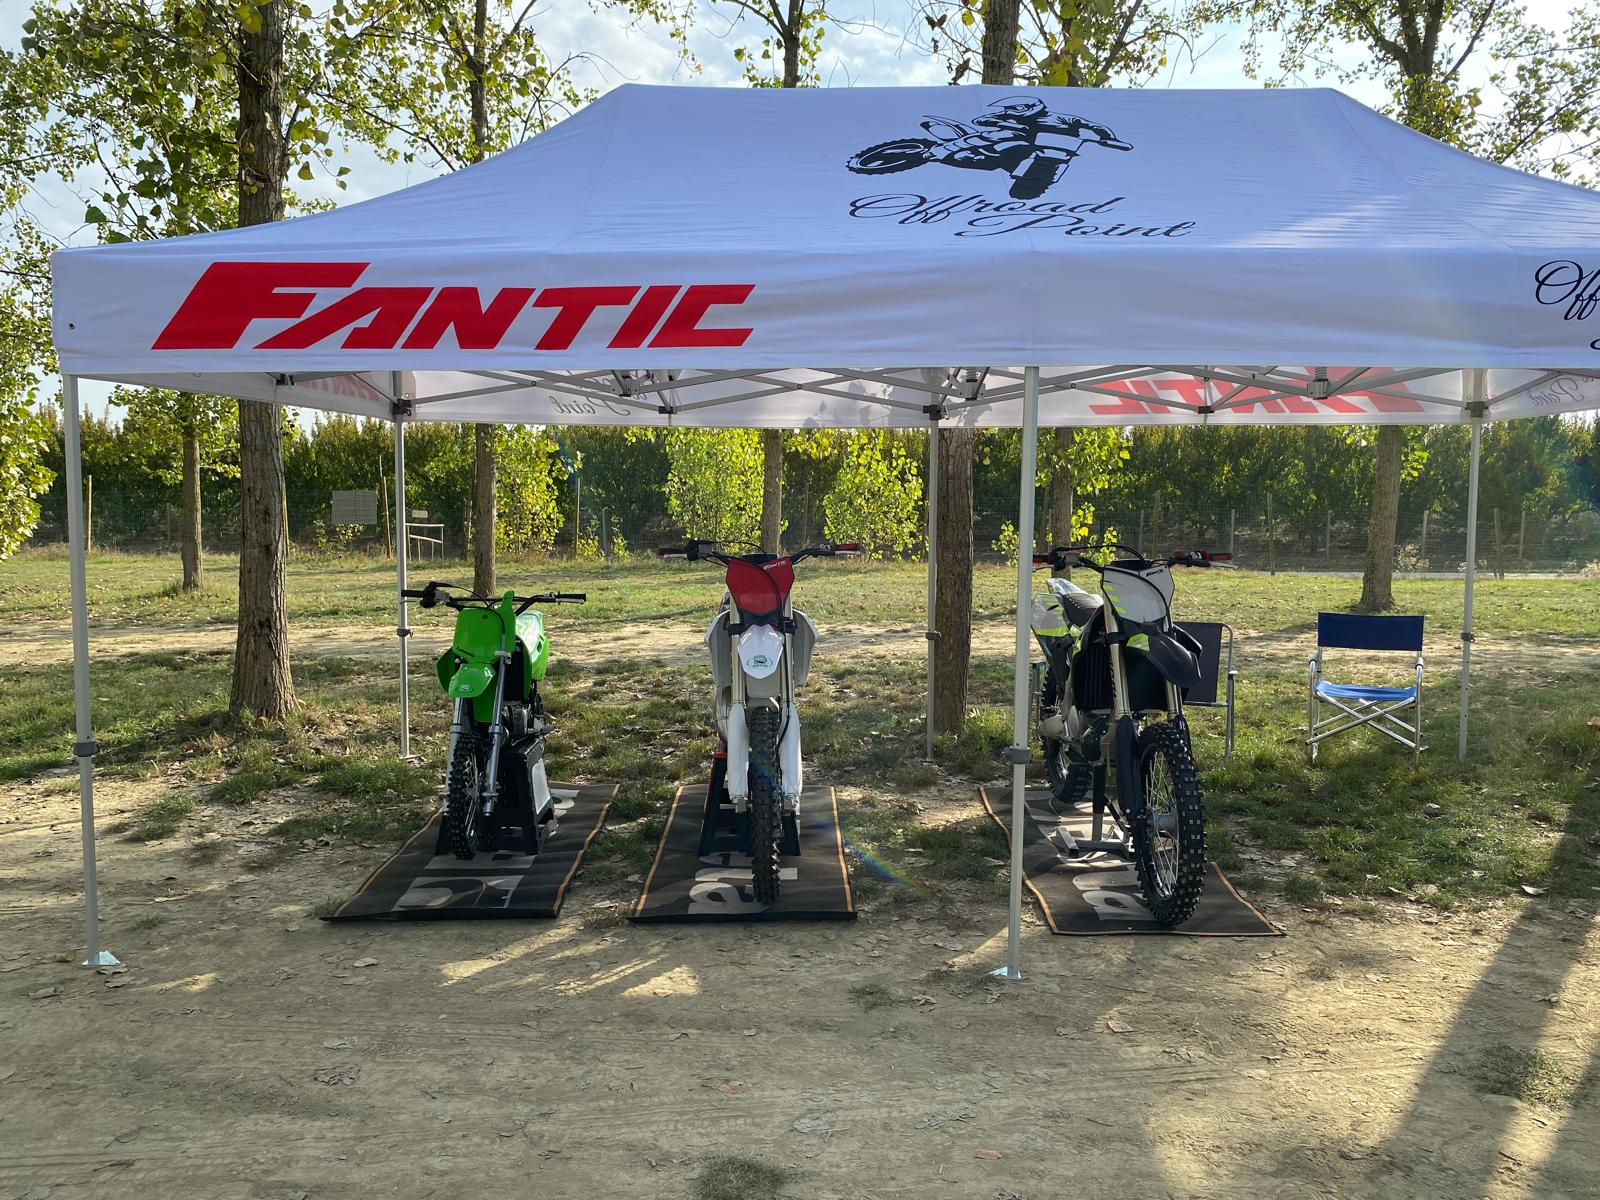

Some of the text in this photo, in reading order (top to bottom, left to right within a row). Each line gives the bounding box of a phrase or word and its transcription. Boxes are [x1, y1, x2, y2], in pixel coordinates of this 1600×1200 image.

[849, 193, 1125, 225] Offroad
[953, 213, 1196, 237] Point
[151, 262, 756, 350] FANTIC
[1534, 259, 1600, 321] Off
